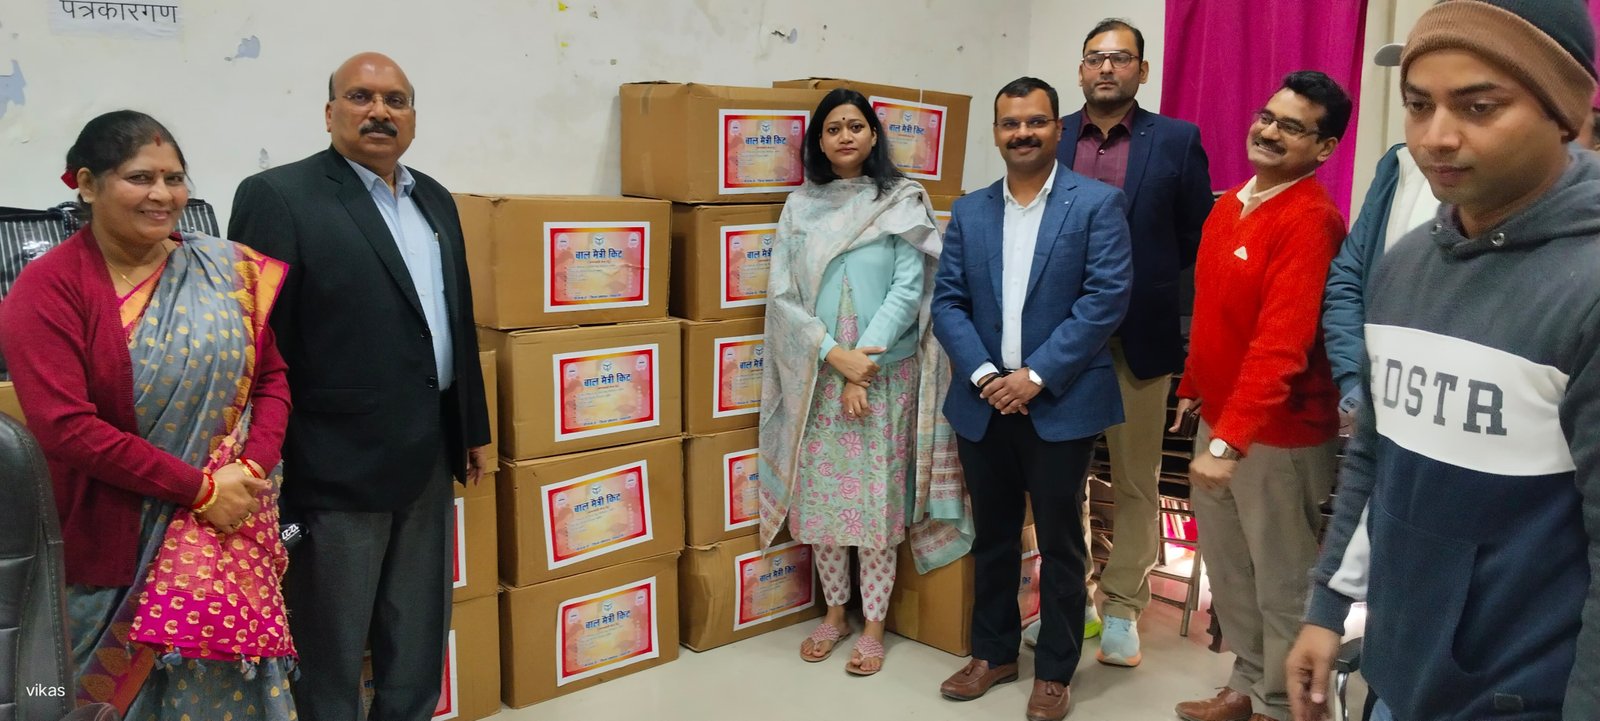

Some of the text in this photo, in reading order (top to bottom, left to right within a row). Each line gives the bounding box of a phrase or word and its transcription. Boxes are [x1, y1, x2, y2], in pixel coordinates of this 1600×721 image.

[59, 0, 178, 23] पत्रकारगण
[575, 250, 590, 259] बाल
[608, 247, 623, 259] किट
[584, 378, 599, 387] बाल
[616, 372, 631, 383] किट
[574, 502, 589, 513] बाल
[606, 493, 621, 504] किट
[585, 619, 600, 629] बाल
[616, 610, 631, 621] किट
